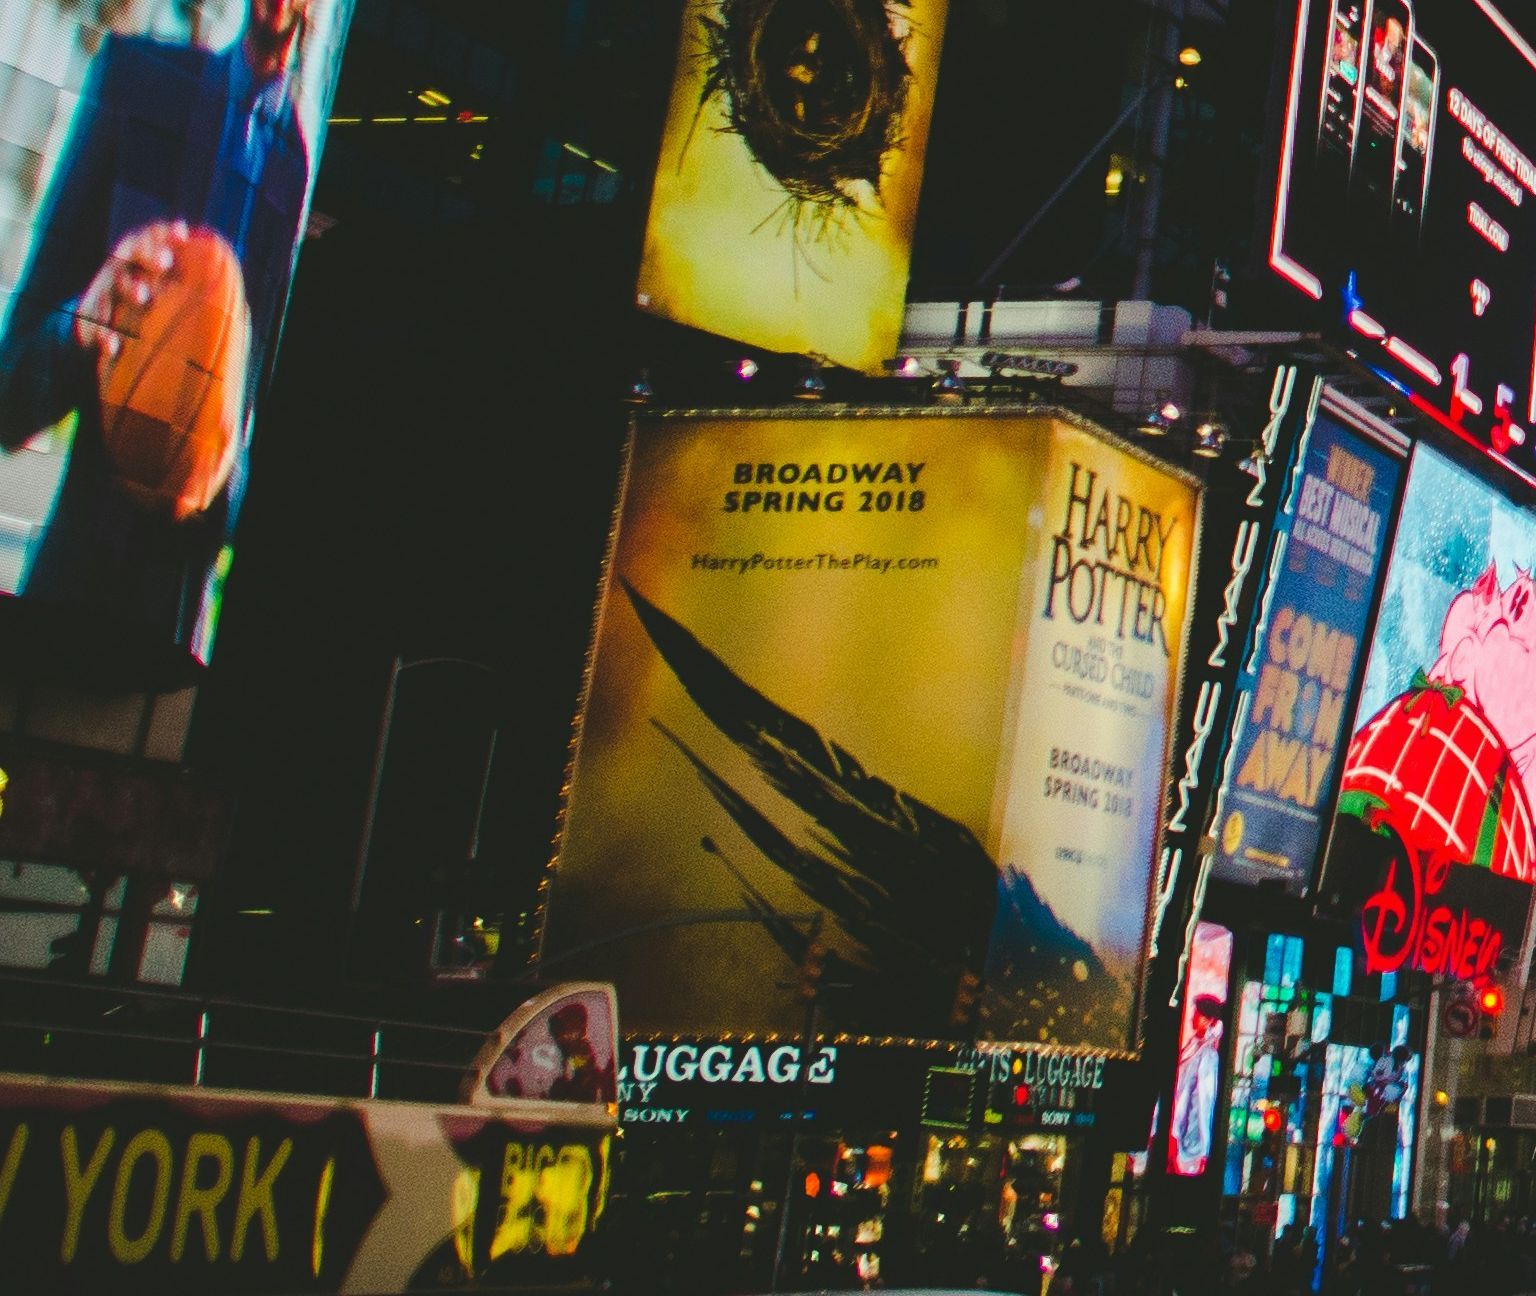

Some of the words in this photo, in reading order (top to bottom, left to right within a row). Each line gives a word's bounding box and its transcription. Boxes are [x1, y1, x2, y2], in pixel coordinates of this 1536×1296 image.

[732, 461, 926, 486] BROADWAY
[721, 490, 846, 515] SPRING
[857, 489, 927, 515] 2018
[1062, 461, 1178, 583] HARRY
[690, 551, 940, 573] HarryPotterThePlay.com
[1041, 534, 1172, 659] POTTER
[1267, 606, 1358, 693] COME
[1048, 746, 1134, 790] BROADWAY
[1235, 728, 1332, 808] AWAY
[1042, 775, 1100, 810] SPRING
[615, 1045, 837, 1085] UGGAGE
[622, 1108, 690, 1124] SONY
[60, 1124, 294, 1265] YORK
